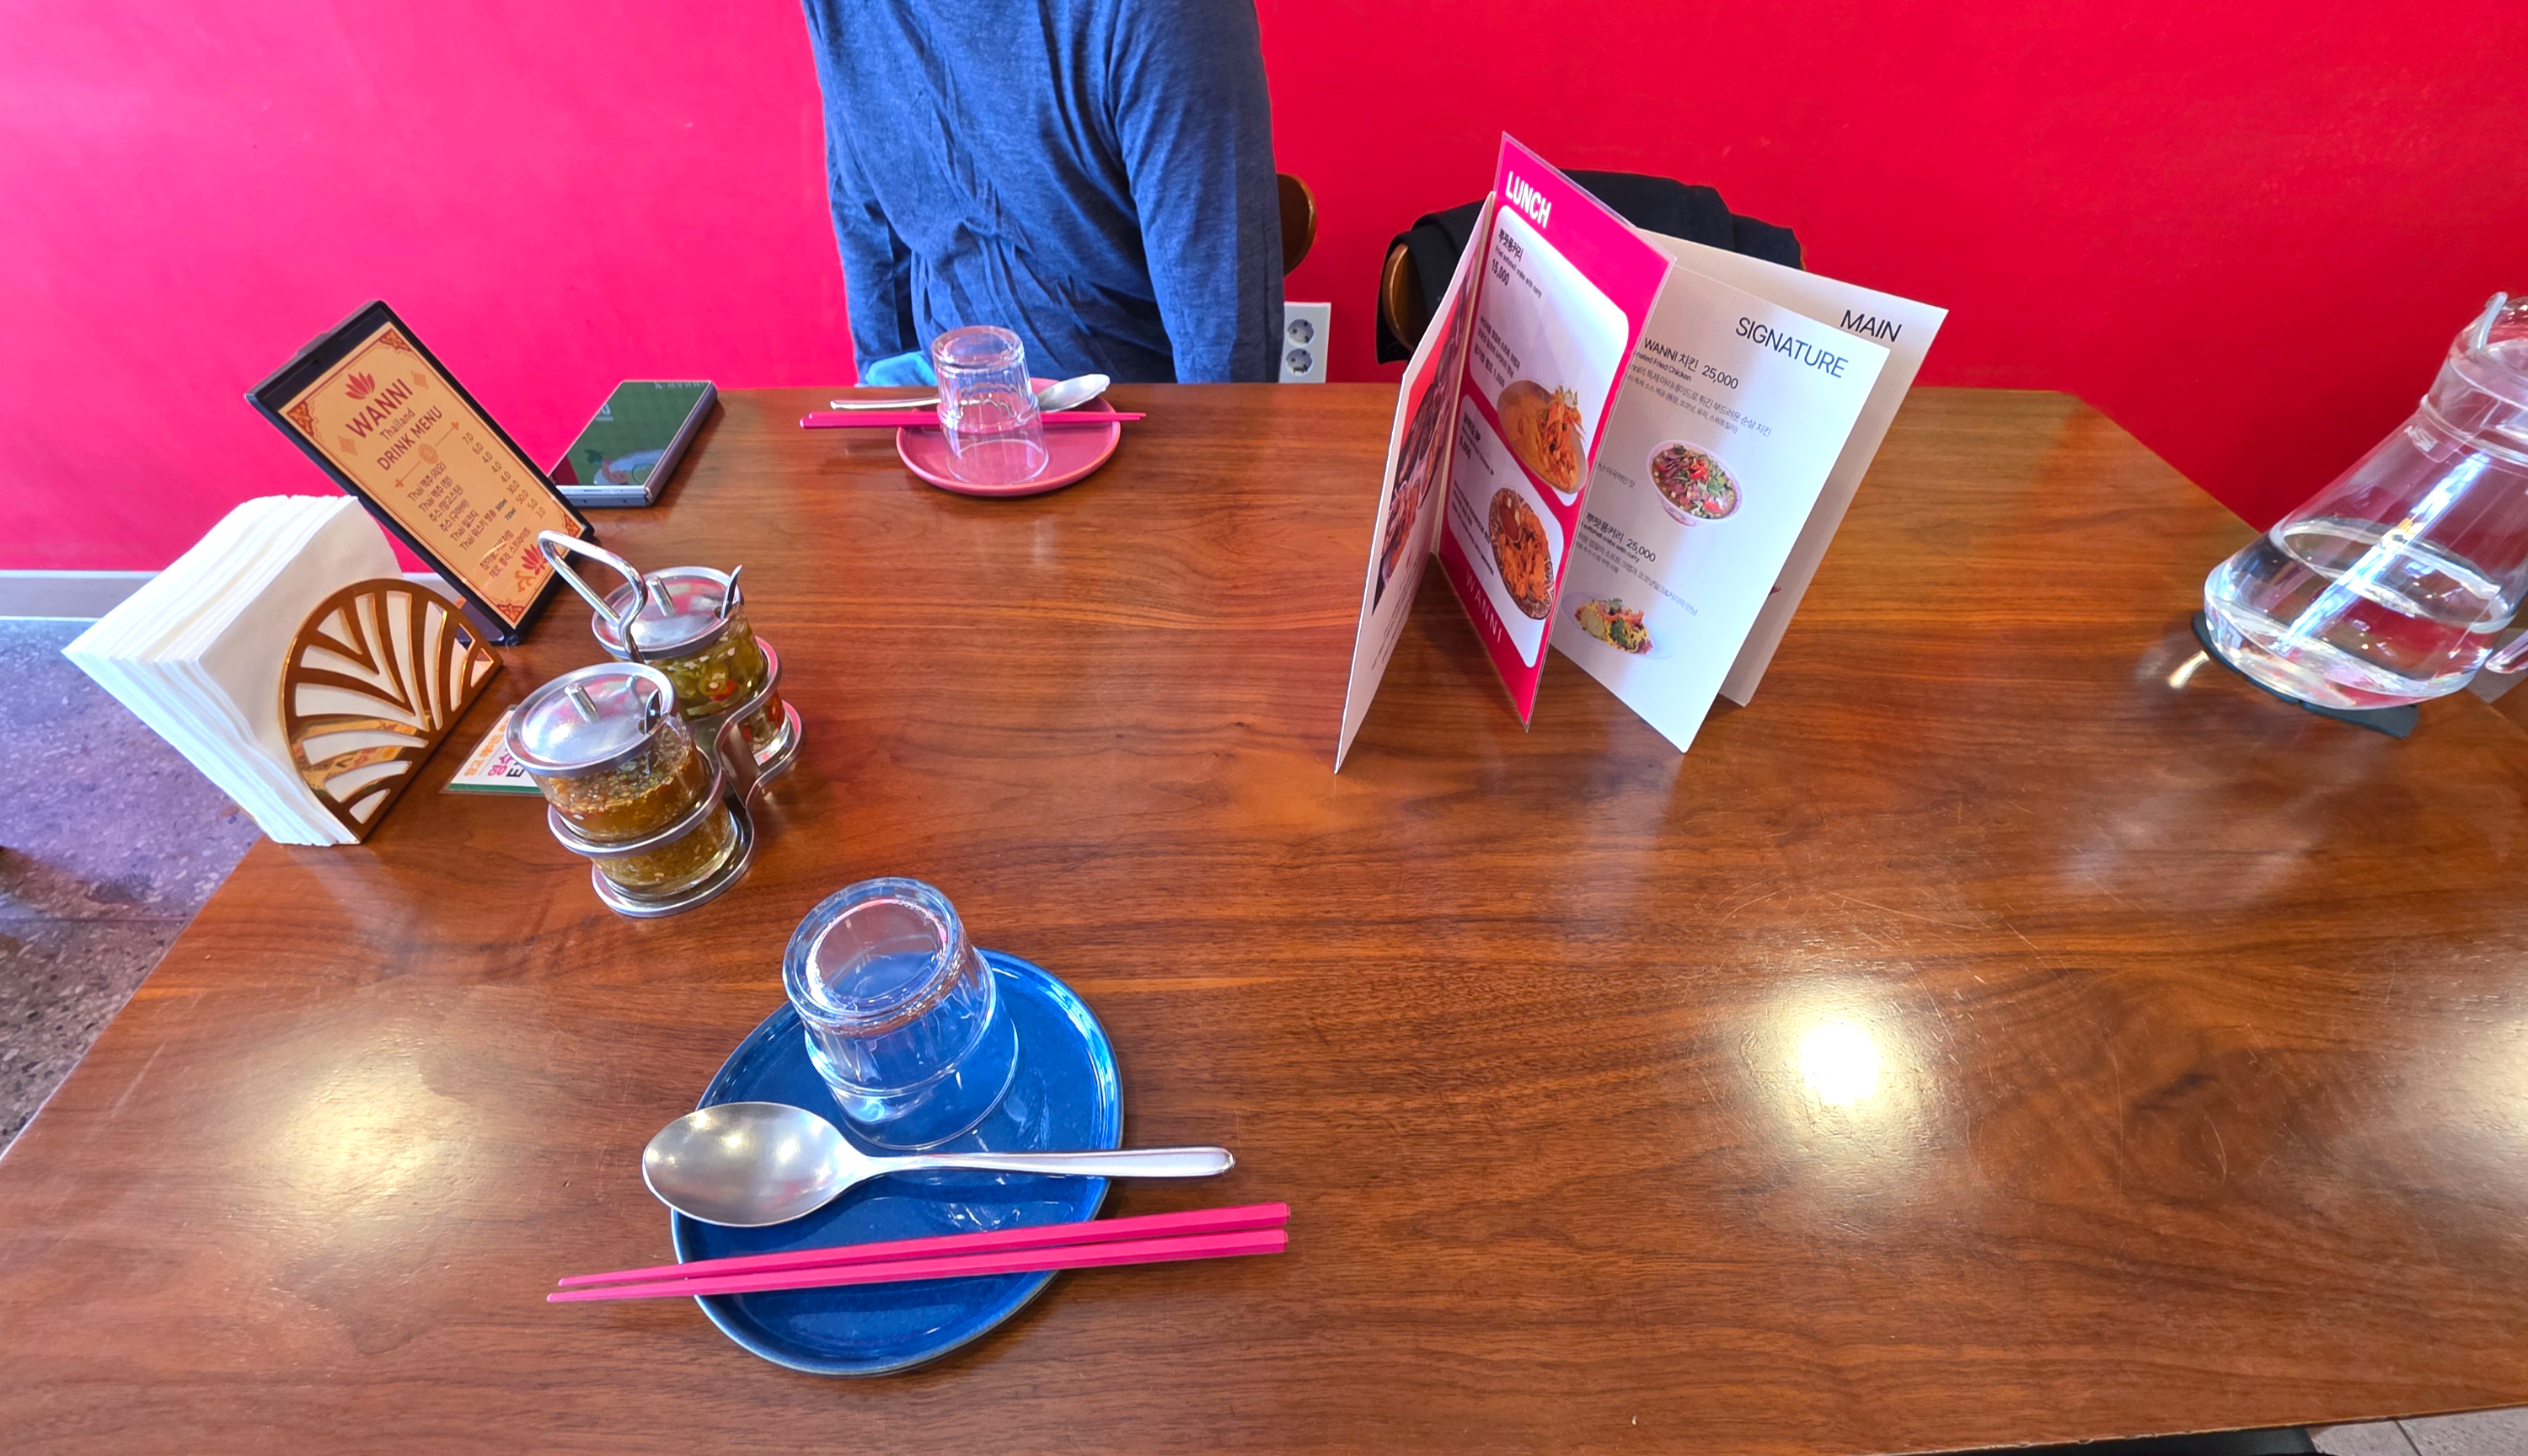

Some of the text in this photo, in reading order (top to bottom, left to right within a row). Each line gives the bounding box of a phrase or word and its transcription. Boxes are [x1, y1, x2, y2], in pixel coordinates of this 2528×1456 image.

[1505, 170, 1552, 229] LUNCH
[1492, 258, 1511, 286] 15,000
[1735, 317, 1849, 379] SIGNATURE
[1840, 309, 1903, 343] MAIN
[1634, 351, 1654, 364] nated
[1668, 365, 1693, 383] Chicken
[1644, 337, 1739, 390] WANNI 치킨 25,000
[345, 377, 414, 438] WANNI
[379, 407, 415, 441] Thailand
[1698, 393, 1714, 410] 튀긴
[1712, 401, 1741, 423] 부드러운
[376, 404, 443, 472] DRINK MENU
[407, 484, 425, 502] Thai
[420, 474, 434, 488] 맥주
[462, 431, 474, 446] 7.0
[418, 495, 435, 513] Thai
[431, 484, 445, 499] 맥주
[472, 442, 484, 456] 6.0
[428, 509, 443, 522] 주스
[481, 451, 493, 464] 4.0
[438, 518, 454, 533] 주스
[490, 461, 503, 474] 4.0
[449, 524, 466, 542] Thai
[500, 470, 511, 484] 4.0
[459, 533, 476, 552] Thai
[470, 518, 489, 539] 위스키
[506, 479, 521, 495] 30.0
[515, 489, 530, 506] 50.0
[527, 498, 538, 511] 5.0
[534, 506, 547, 520] 3.0
[1586, 511, 1657, 563] 뿌팟퐁커리 25,000
[1466, 570, 1502, 644] WANNI
[486, 747, 515, 777] 영수
[506, 761, 526, 778] E
